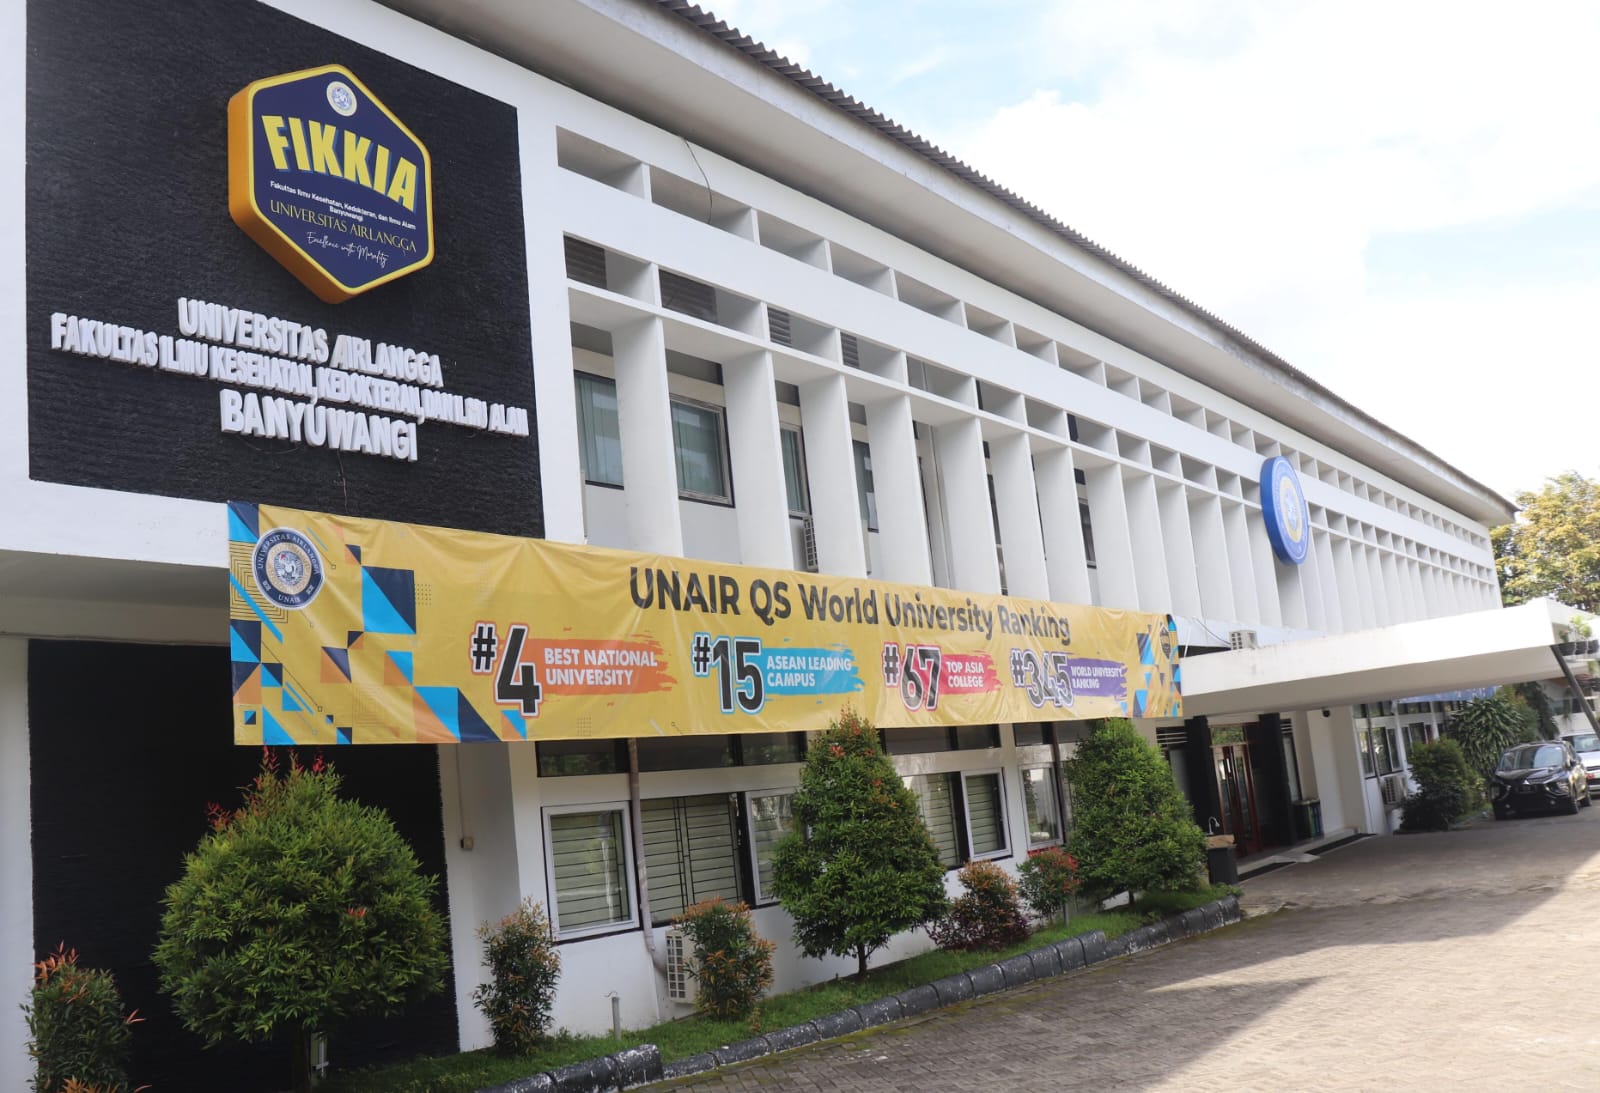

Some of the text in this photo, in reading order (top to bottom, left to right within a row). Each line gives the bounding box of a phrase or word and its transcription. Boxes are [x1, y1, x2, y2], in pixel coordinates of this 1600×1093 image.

[261, 115, 417, 213] FIKKIA
[270, 180, 297, 195] Fakultas
[401, 220, 417, 230] Alam
[270, 199, 417, 256] UNIVERSITAS AIRLANGGA
[51, 312, 159, 367] FAKULTAS
[159, 335, 209, 376] ILMU
[178, 297, 444, 388] UNIVERSITAS AIRLANGGA
[219, 388, 418, 462] BANYUWANGI
[257, 533, 291, 569] UNIVERSITAS
[630, 567, 1071, 646] UNAIR QS World University Ranking
[471, 622, 542, 717] #4
[544, 647, 658, 668] BEST NATIONAL
[545, 668, 634, 686] UNIVERSITY
[693, 633, 764, 712] #15
[766, 655, 852, 672] ASEAN LEADING
[767, 672, 816, 688] CAMPUS
[883, 642, 941, 710] #67
[946, 660, 985, 675] TOP ASIA
[948, 675, 985, 689] COLLEGE
[1070, 665, 1124, 678] WORLD UNIVERSITY
[1071, 678, 1100, 689] RANKING
